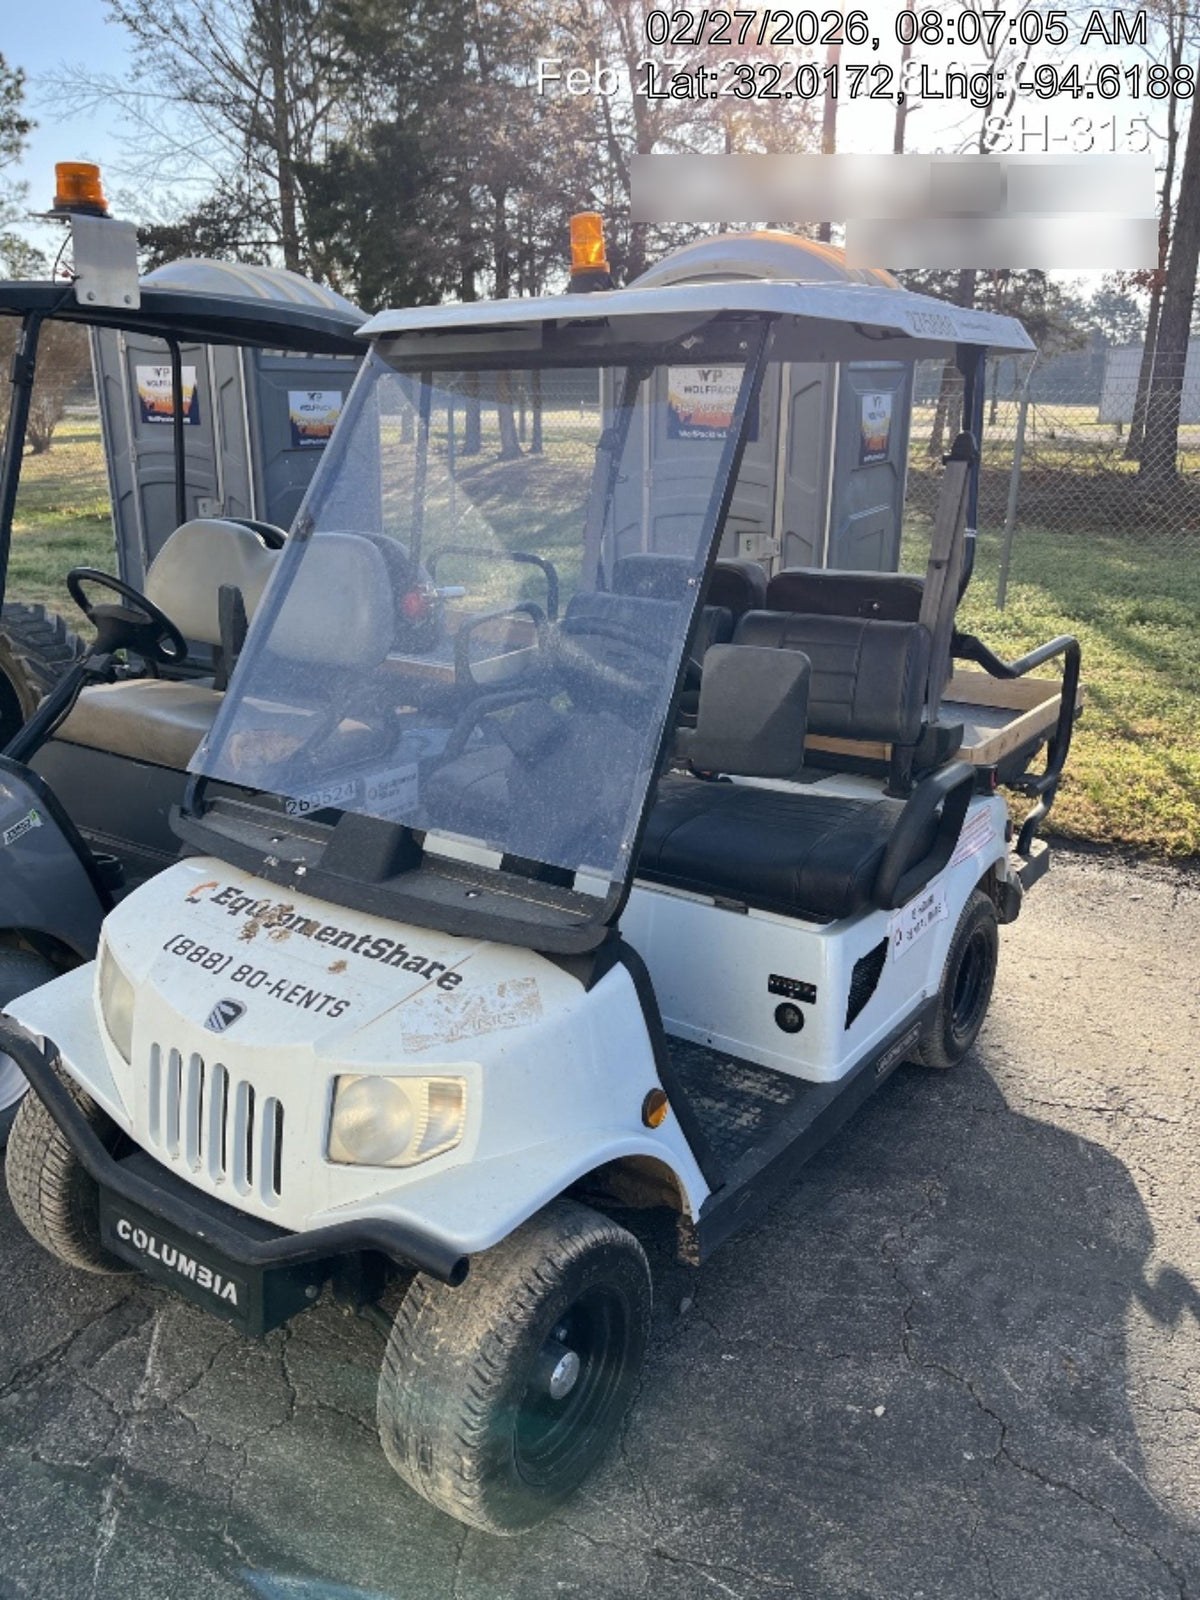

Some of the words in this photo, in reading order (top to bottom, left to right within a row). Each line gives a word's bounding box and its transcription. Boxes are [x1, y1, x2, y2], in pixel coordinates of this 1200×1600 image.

[162, 934, 233, 975] (888)
[209, 886, 463, 991] EqupmentShare
[230, 963, 351, 1018] 80-RENTS
[117, 1219, 238, 1306] COLUMBIA
